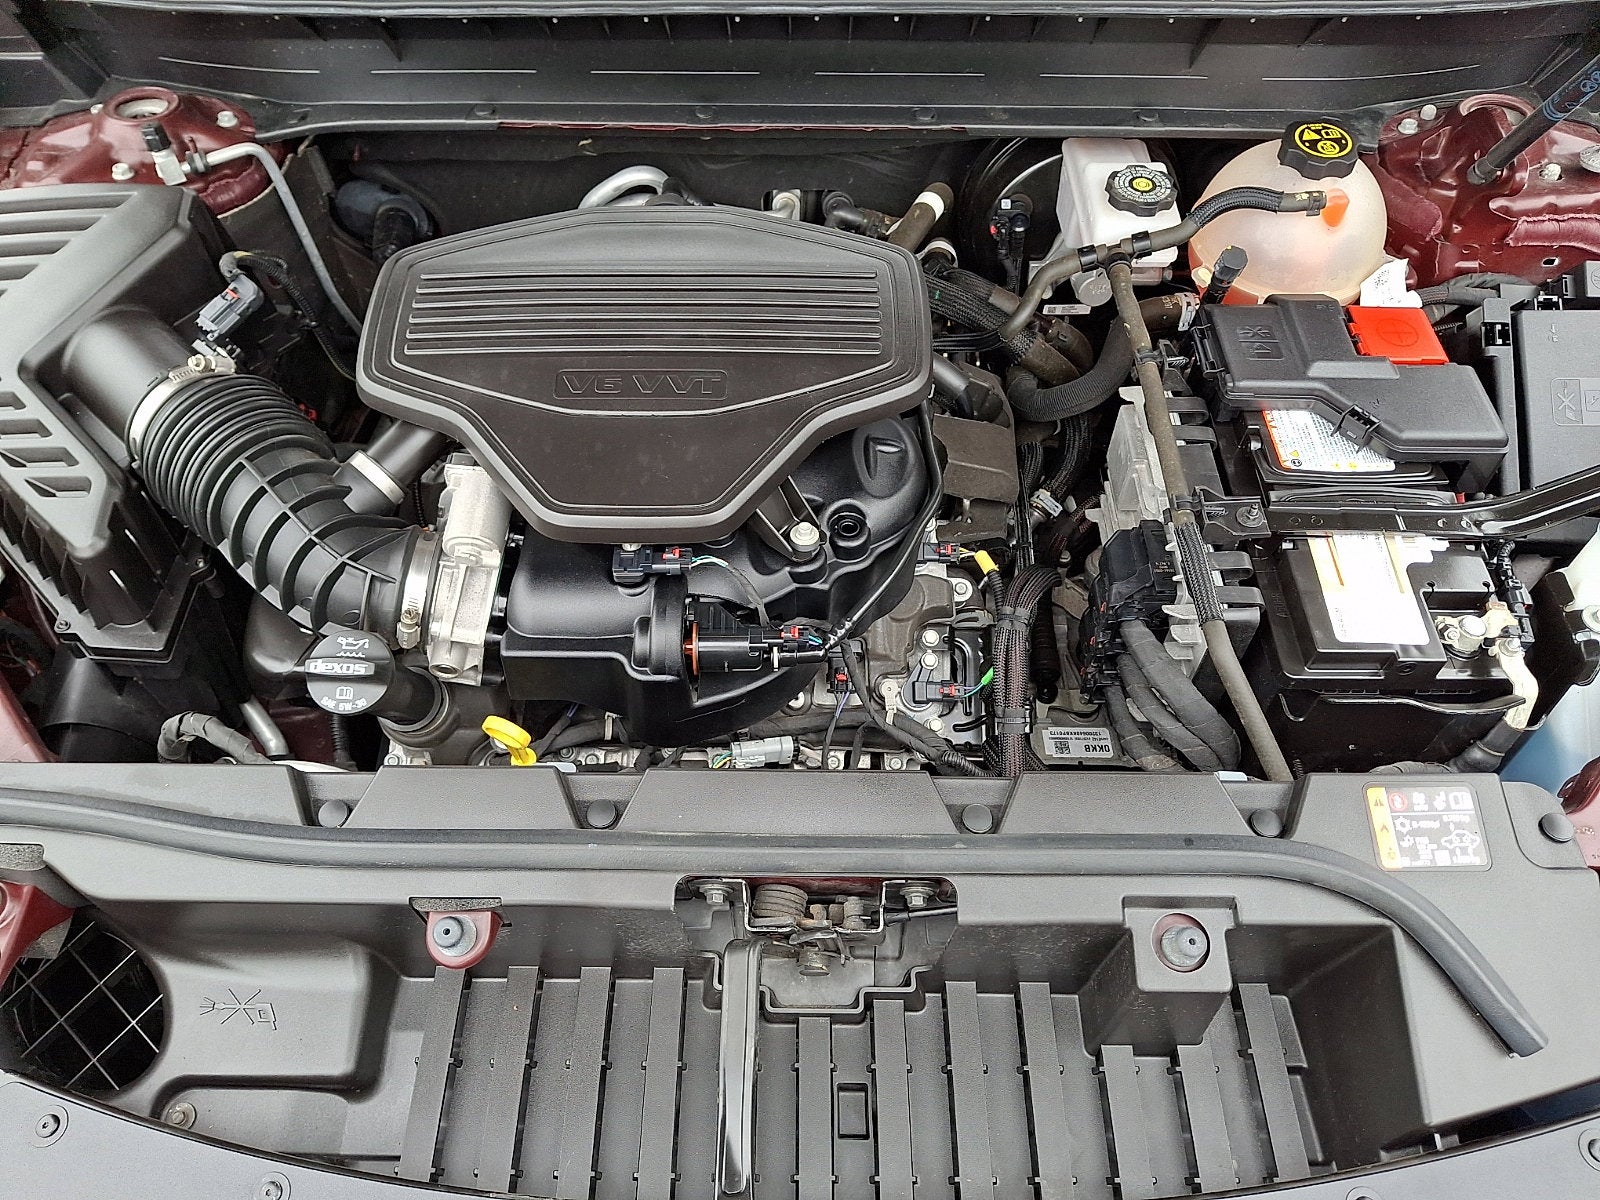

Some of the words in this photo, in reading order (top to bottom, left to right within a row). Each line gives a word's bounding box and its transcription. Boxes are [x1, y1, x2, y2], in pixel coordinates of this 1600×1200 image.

[562, 375, 623, 394] V6
[632, 375, 722, 394] VVT
[310, 659, 369, 675] dexos
[320, 696, 337, 709] SAE
